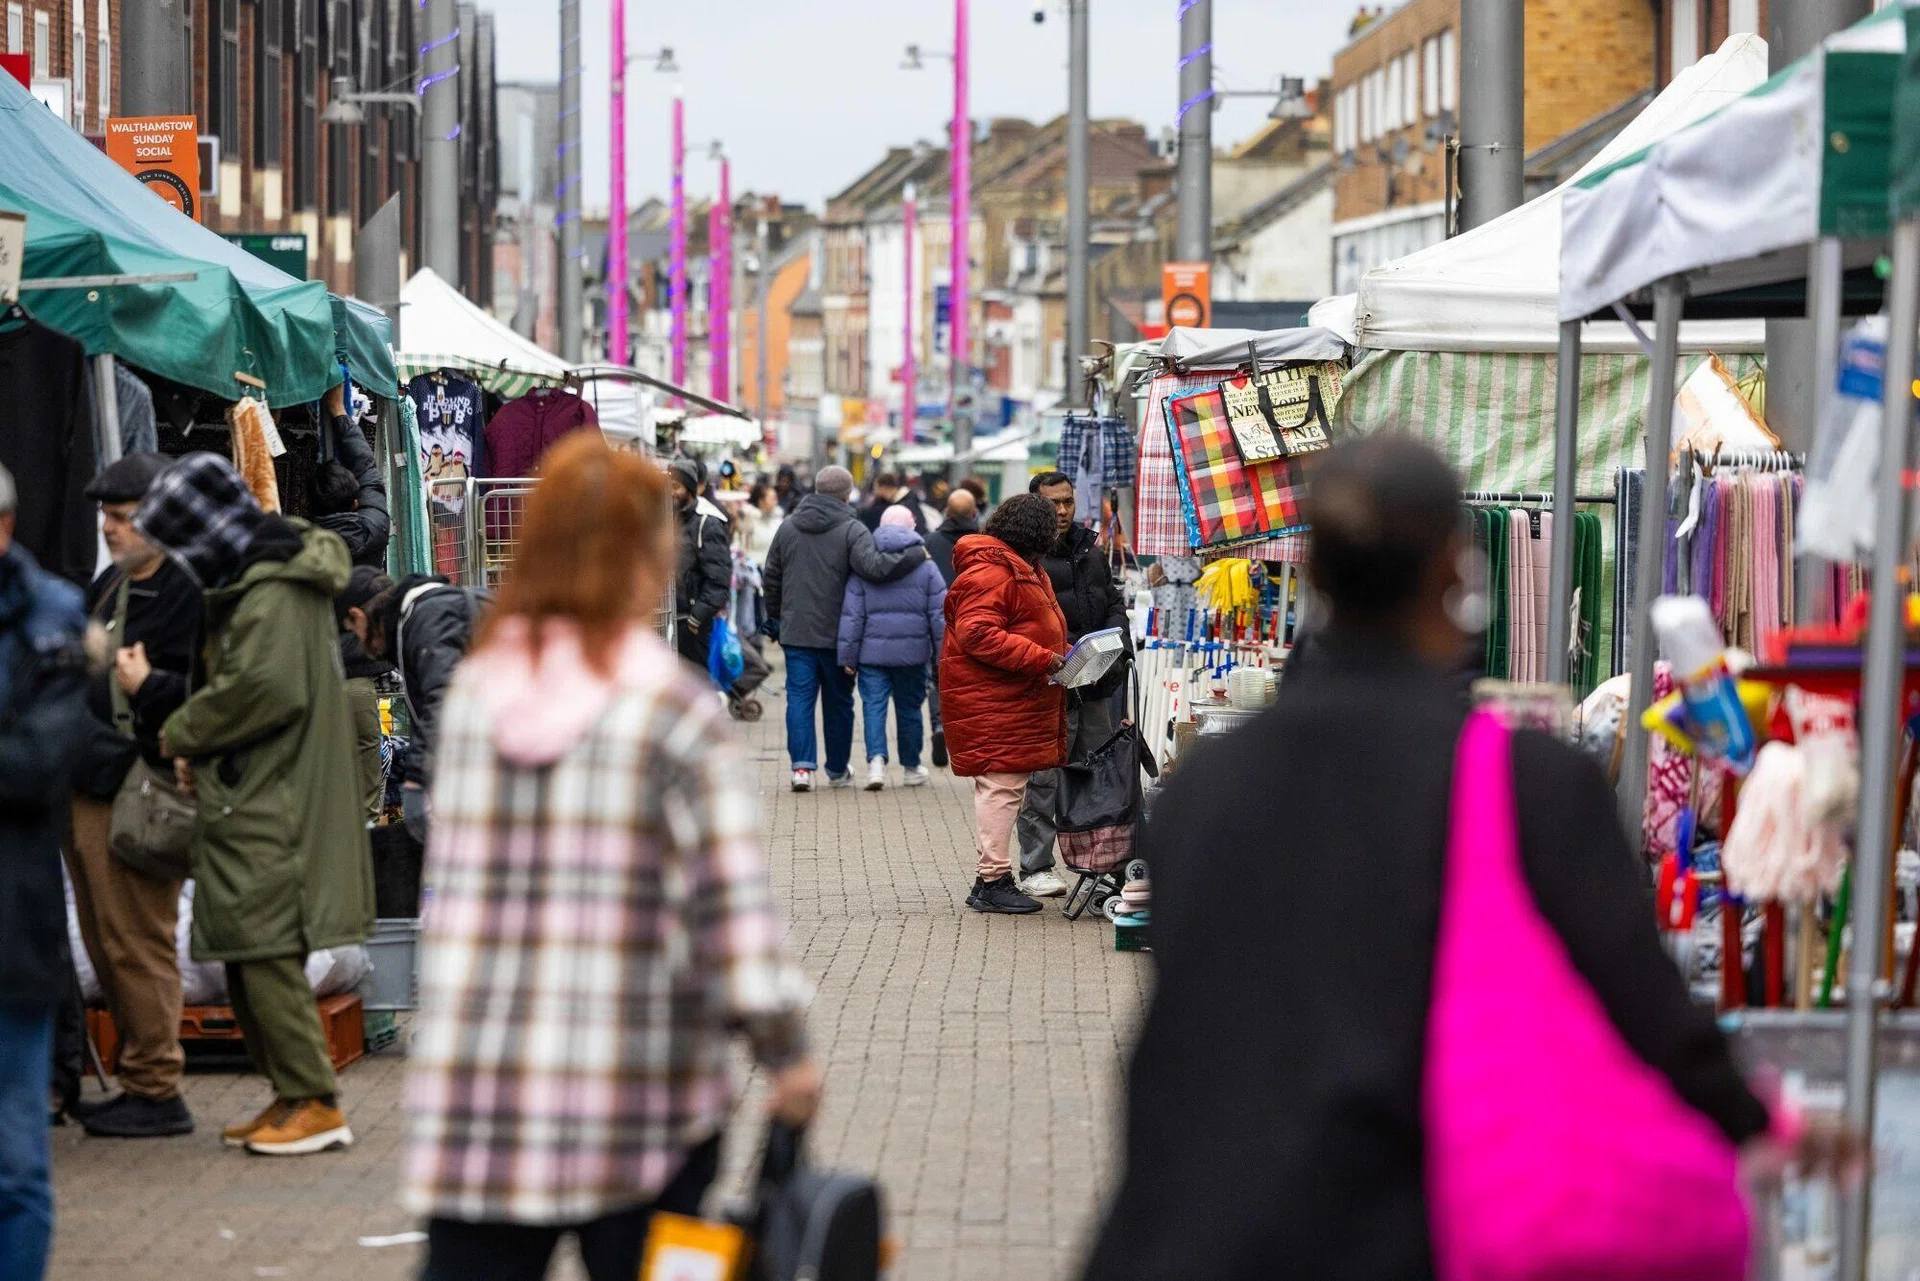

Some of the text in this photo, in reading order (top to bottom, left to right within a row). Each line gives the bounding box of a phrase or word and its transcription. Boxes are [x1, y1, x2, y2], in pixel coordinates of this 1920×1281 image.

[111, 121, 193, 133] WALTHAMSTOW
[133, 134, 174, 145] SUNDAY
[136, 147, 172, 157] SOCIAL
[1332, 377, 1340, 396] YORK
[443, 396, 471, 407] OUND
[428, 409, 465, 424] PB
[1292, 425, 1320, 440] NE
